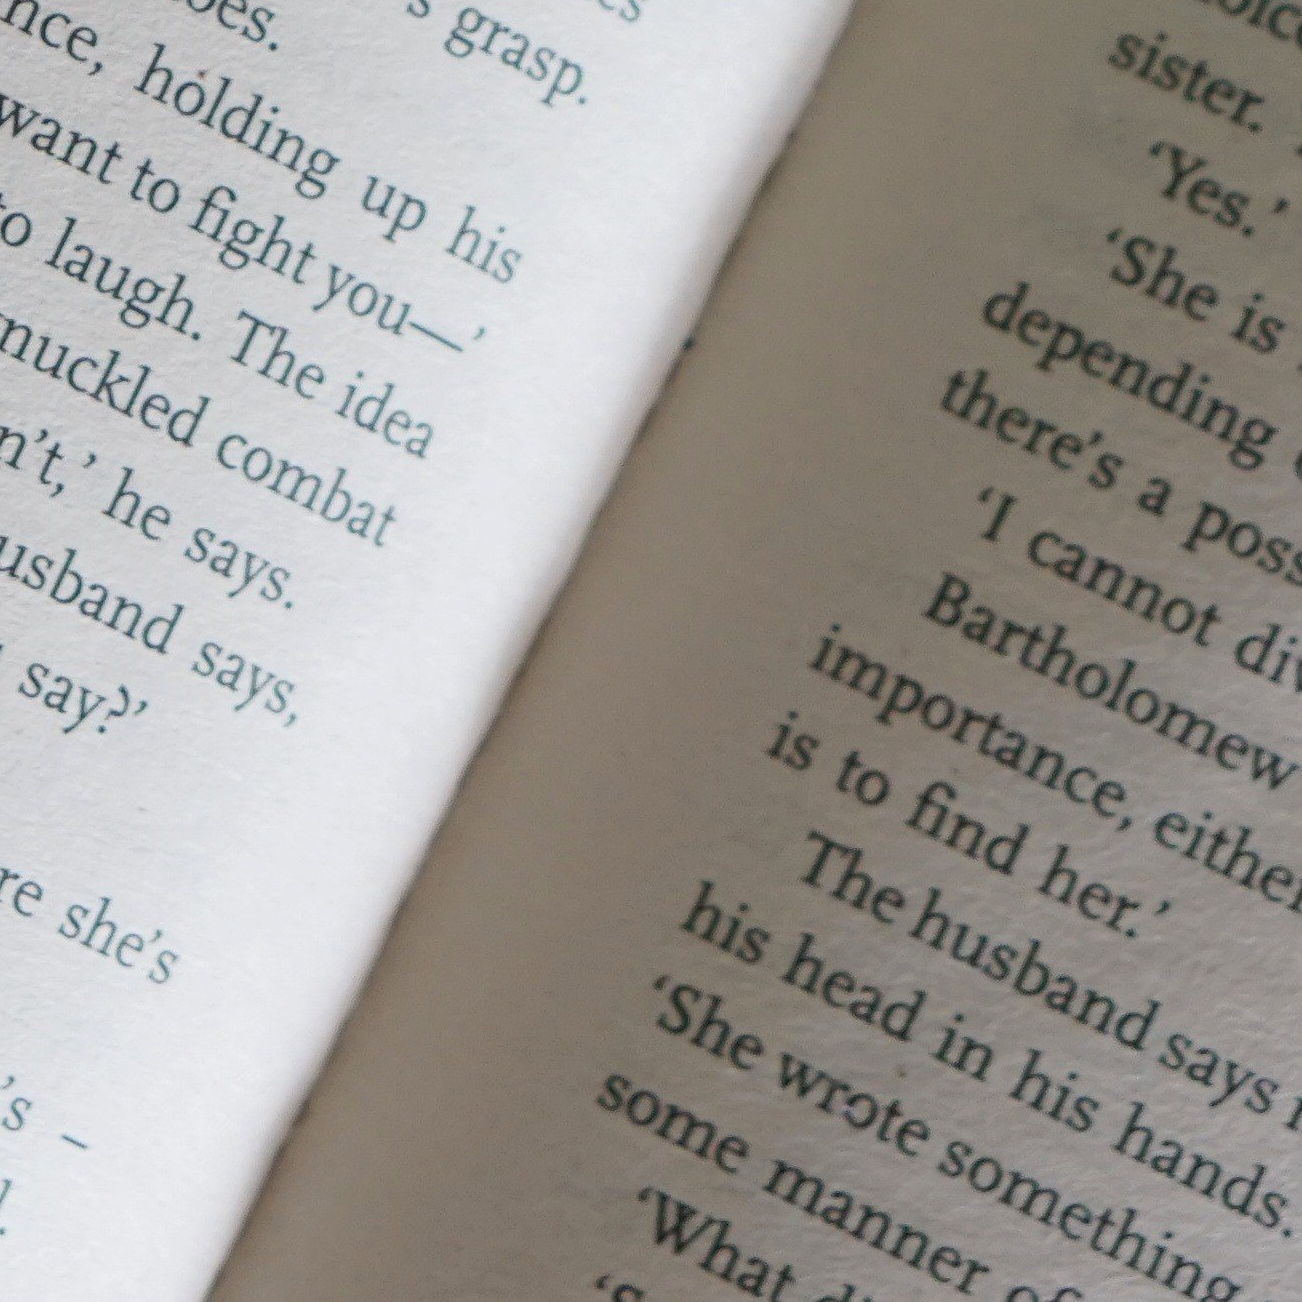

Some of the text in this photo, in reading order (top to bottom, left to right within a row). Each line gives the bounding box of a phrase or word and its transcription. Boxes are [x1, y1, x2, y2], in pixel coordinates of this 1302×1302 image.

[444, 8, 586, 106] grasp.
[1108, 34, 1265, 133] sister.
[45, 217, 200, 341] laugh.
[231, 310, 325, 399] The
[336, 383, 432, 459] idea
[982, 282, 1277, 471] depending
[1231, 295, 1286, 353] is
[102, 467, 171, 540] he
[184, 528, 292, 609] says.
[1028, 531, 1220, 647] cannot
[809, 626, 1132, 832] importance,
[923, 573, 1299, 790] Bartholomew
[766, 712, 819, 771] is
[836, 751, 890, 806] to
[906, 781, 1030, 876] find
[58, 897, 178, 984] she’s
[801, 830, 1281, 1115] The husband says
[680, 880, 1292, 1238] his head in his hands.
[596, 1074, 990, 1294] some manner
[780, 1053, 930, 1157] wrote
[937, 1141, 1242, 1302] something
